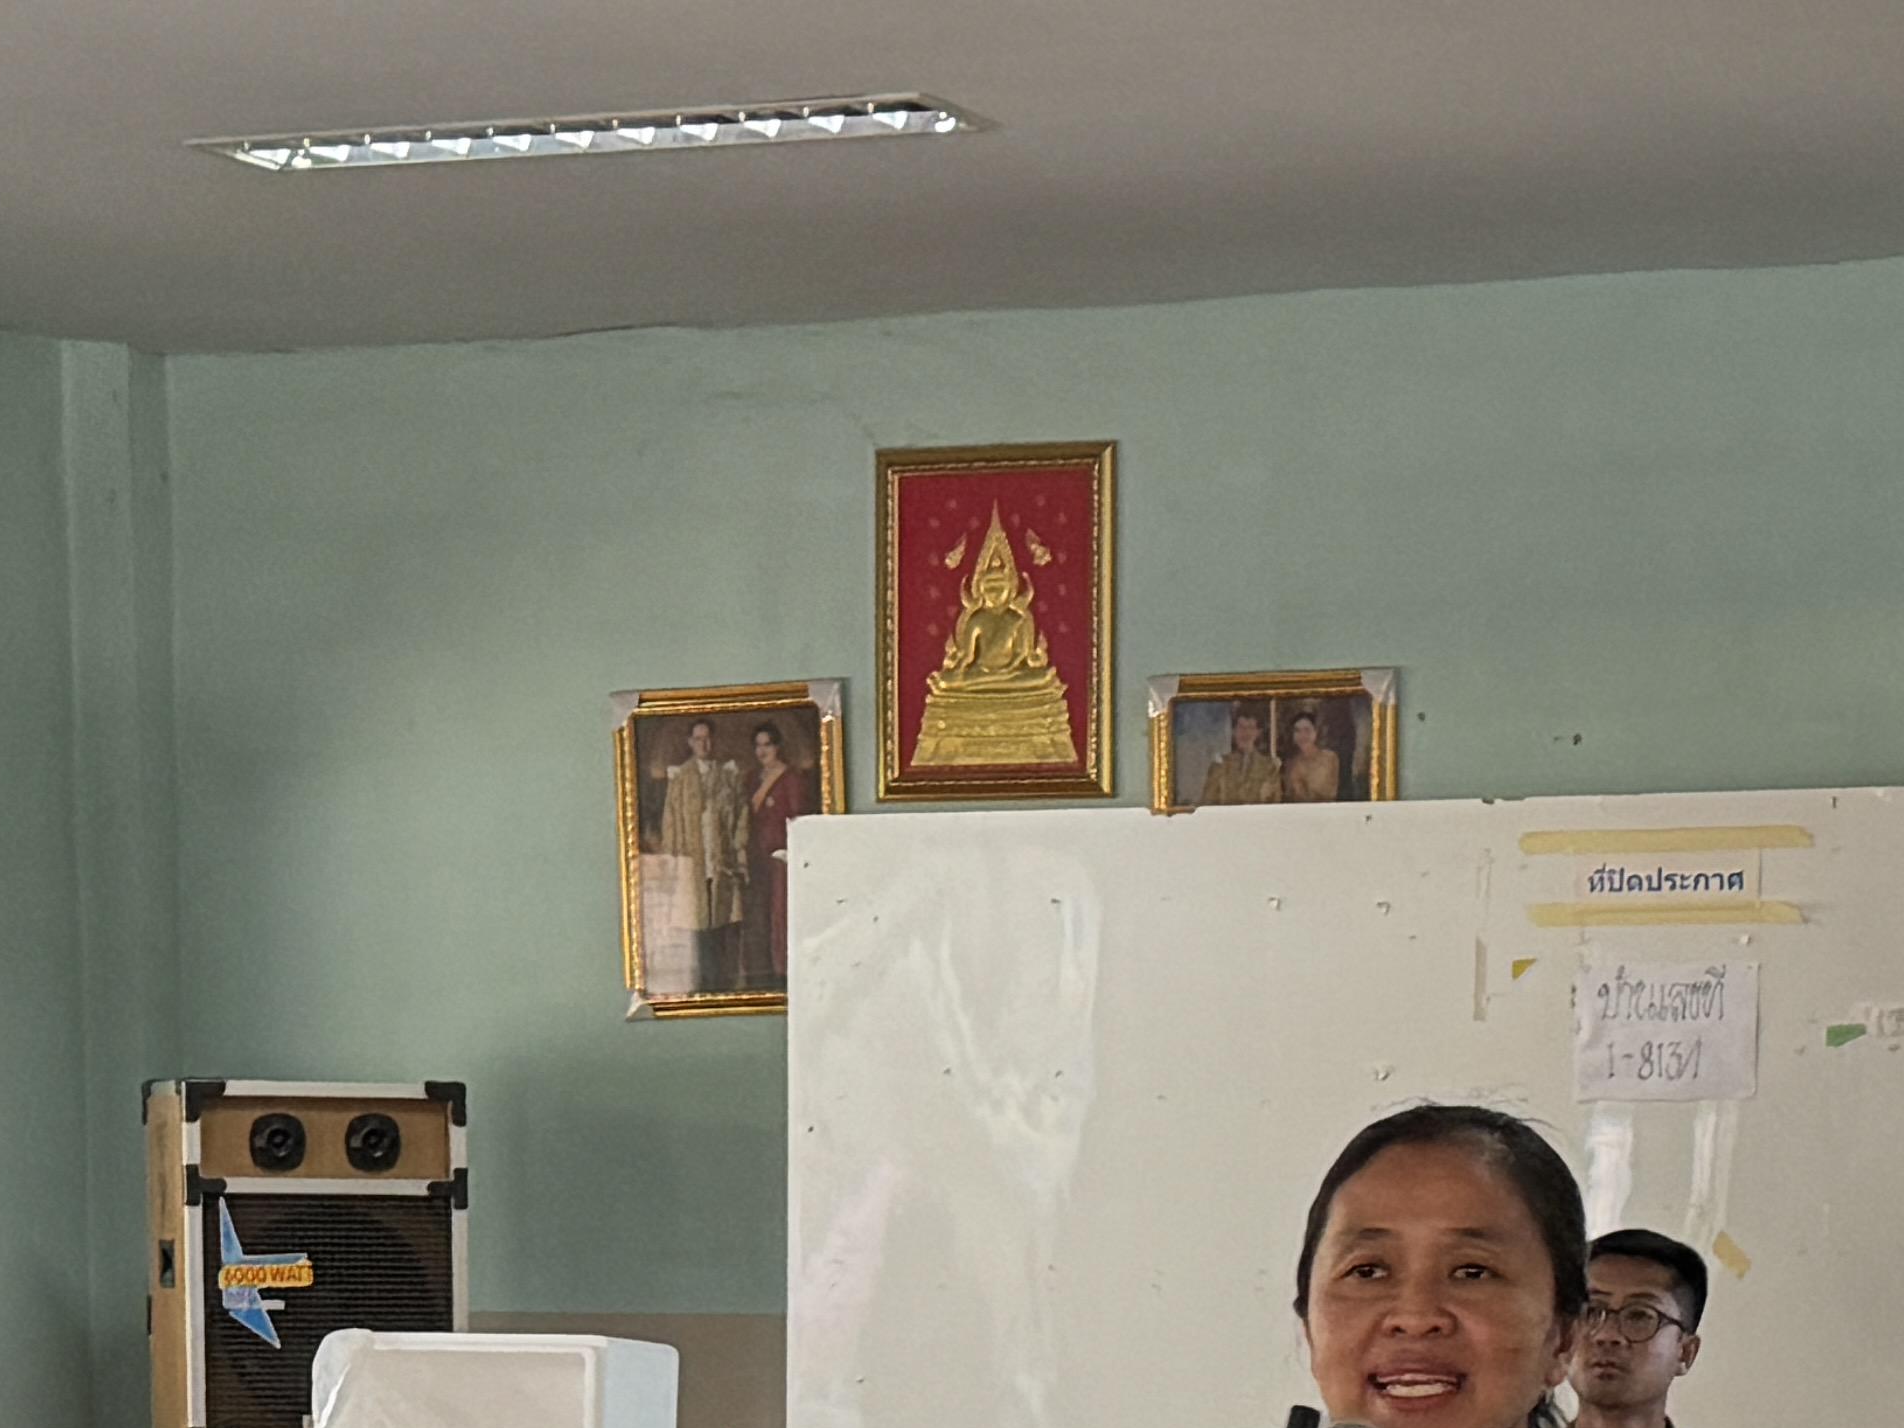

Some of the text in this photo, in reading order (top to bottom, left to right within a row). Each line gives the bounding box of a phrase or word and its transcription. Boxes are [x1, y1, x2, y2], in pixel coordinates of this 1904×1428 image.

[1587, 863, 1745, 894] ที่ปิดประกาศ
